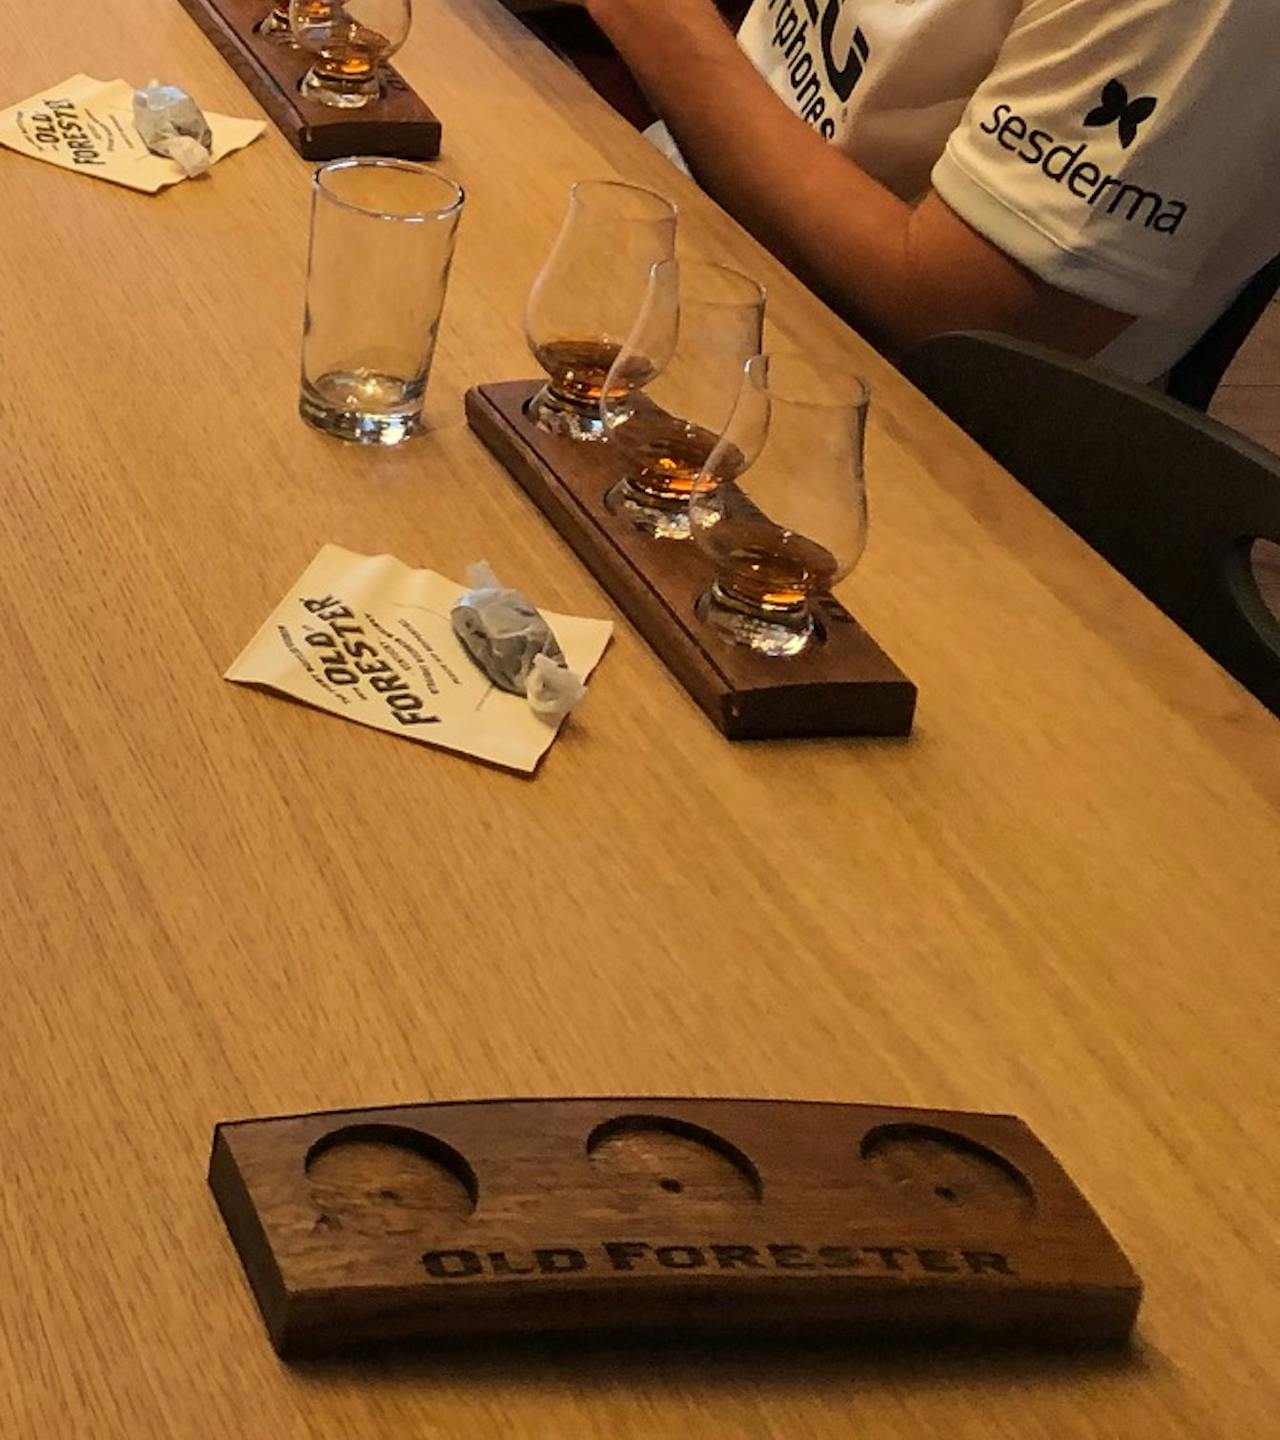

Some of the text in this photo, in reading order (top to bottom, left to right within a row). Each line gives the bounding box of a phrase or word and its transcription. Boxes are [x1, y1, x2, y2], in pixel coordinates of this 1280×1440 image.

[979, 102, 1188, 235] sesderma
[300, 594, 441, 726] FORESTER
[303, 631, 360, 686] OLD
[421, 1241, 1019, 1280] OLD FORESTER
